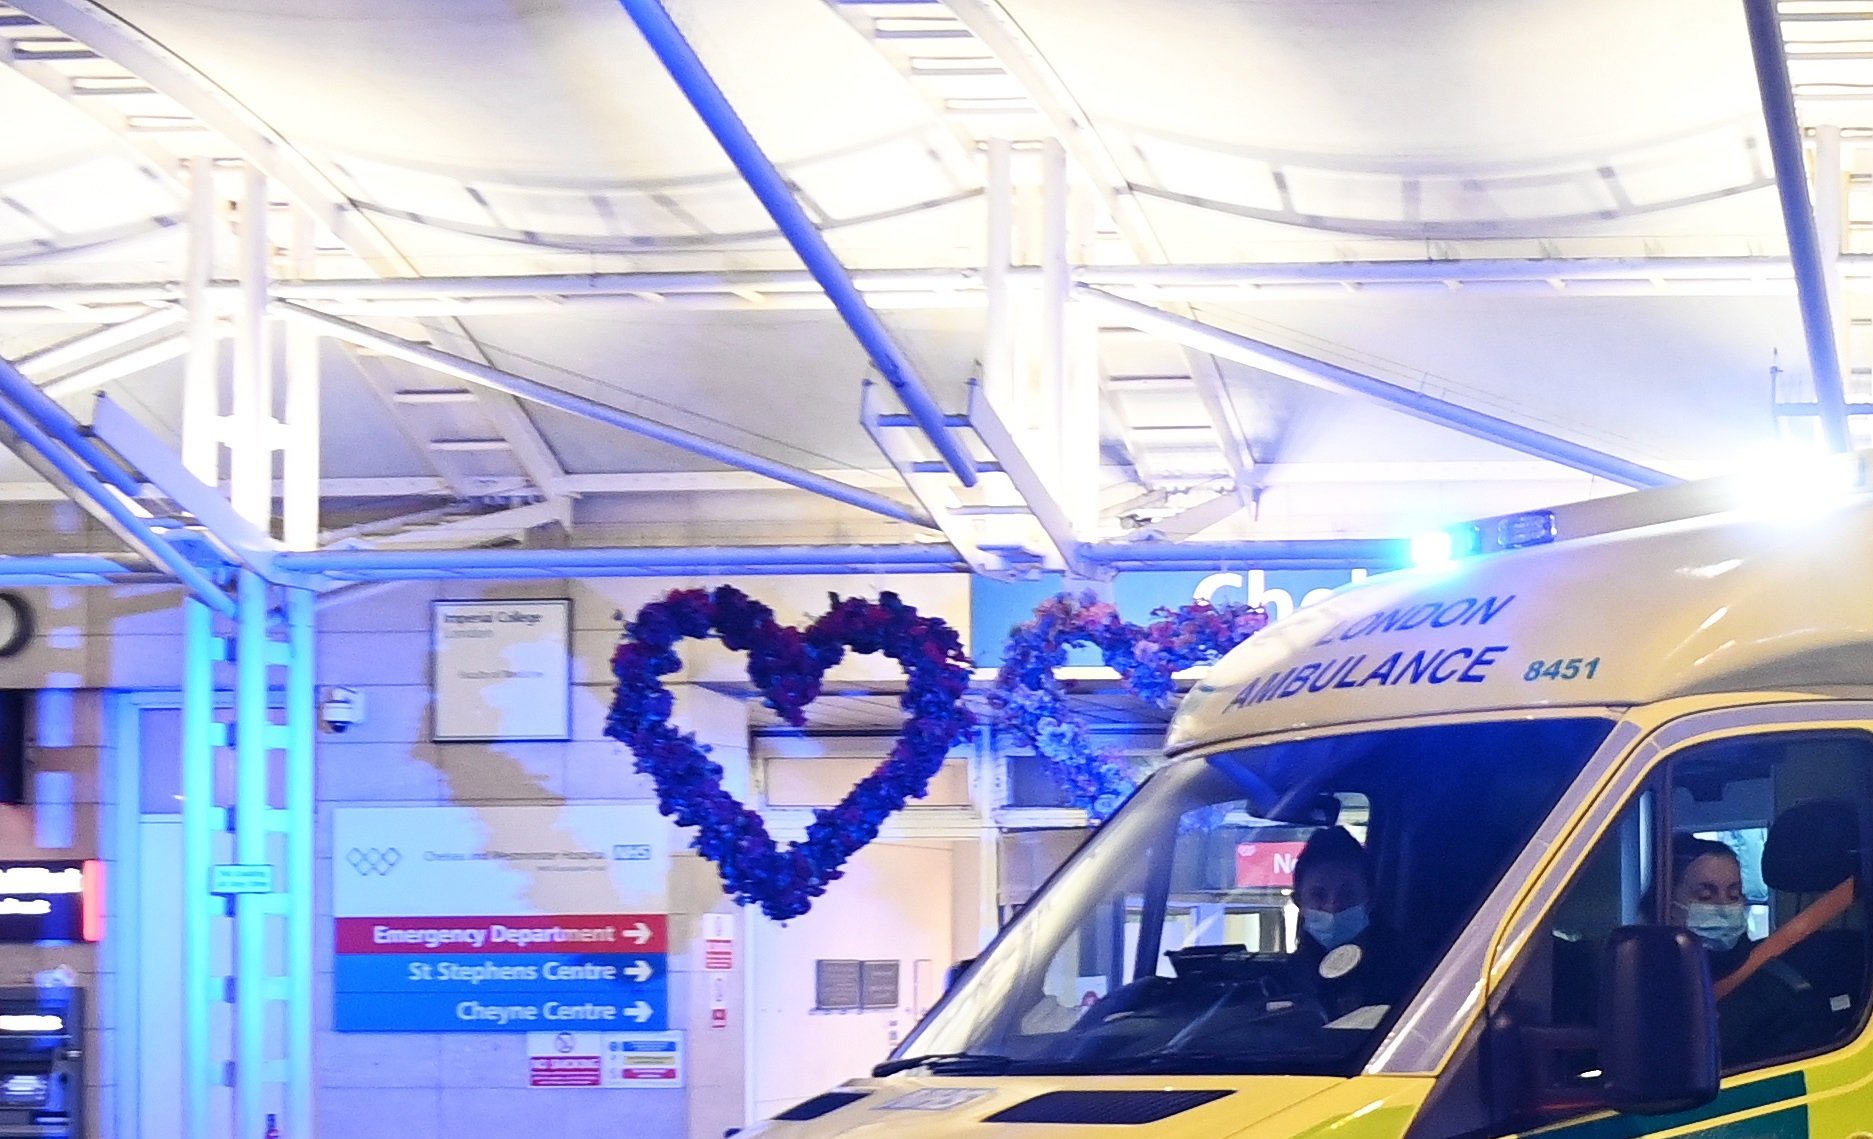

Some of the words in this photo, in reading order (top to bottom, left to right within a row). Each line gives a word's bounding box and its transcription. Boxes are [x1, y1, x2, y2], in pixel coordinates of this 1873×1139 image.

[1315, 594, 1517, 648] LONDON
[1222, 644, 1510, 714] AMBULANCE
[1522, 656, 1601, 683] 8451
[372, 923, 487, 948] Emergency
[489, 923, 616, 947] Department
[407, 960, 433, 980] St
[436, 960, 539, 984] Stephens
[541, 960, 617, 981] Centre
[455, 999, 539, 1024] Cheyne
[542, 999, 617, 1021] Centre
